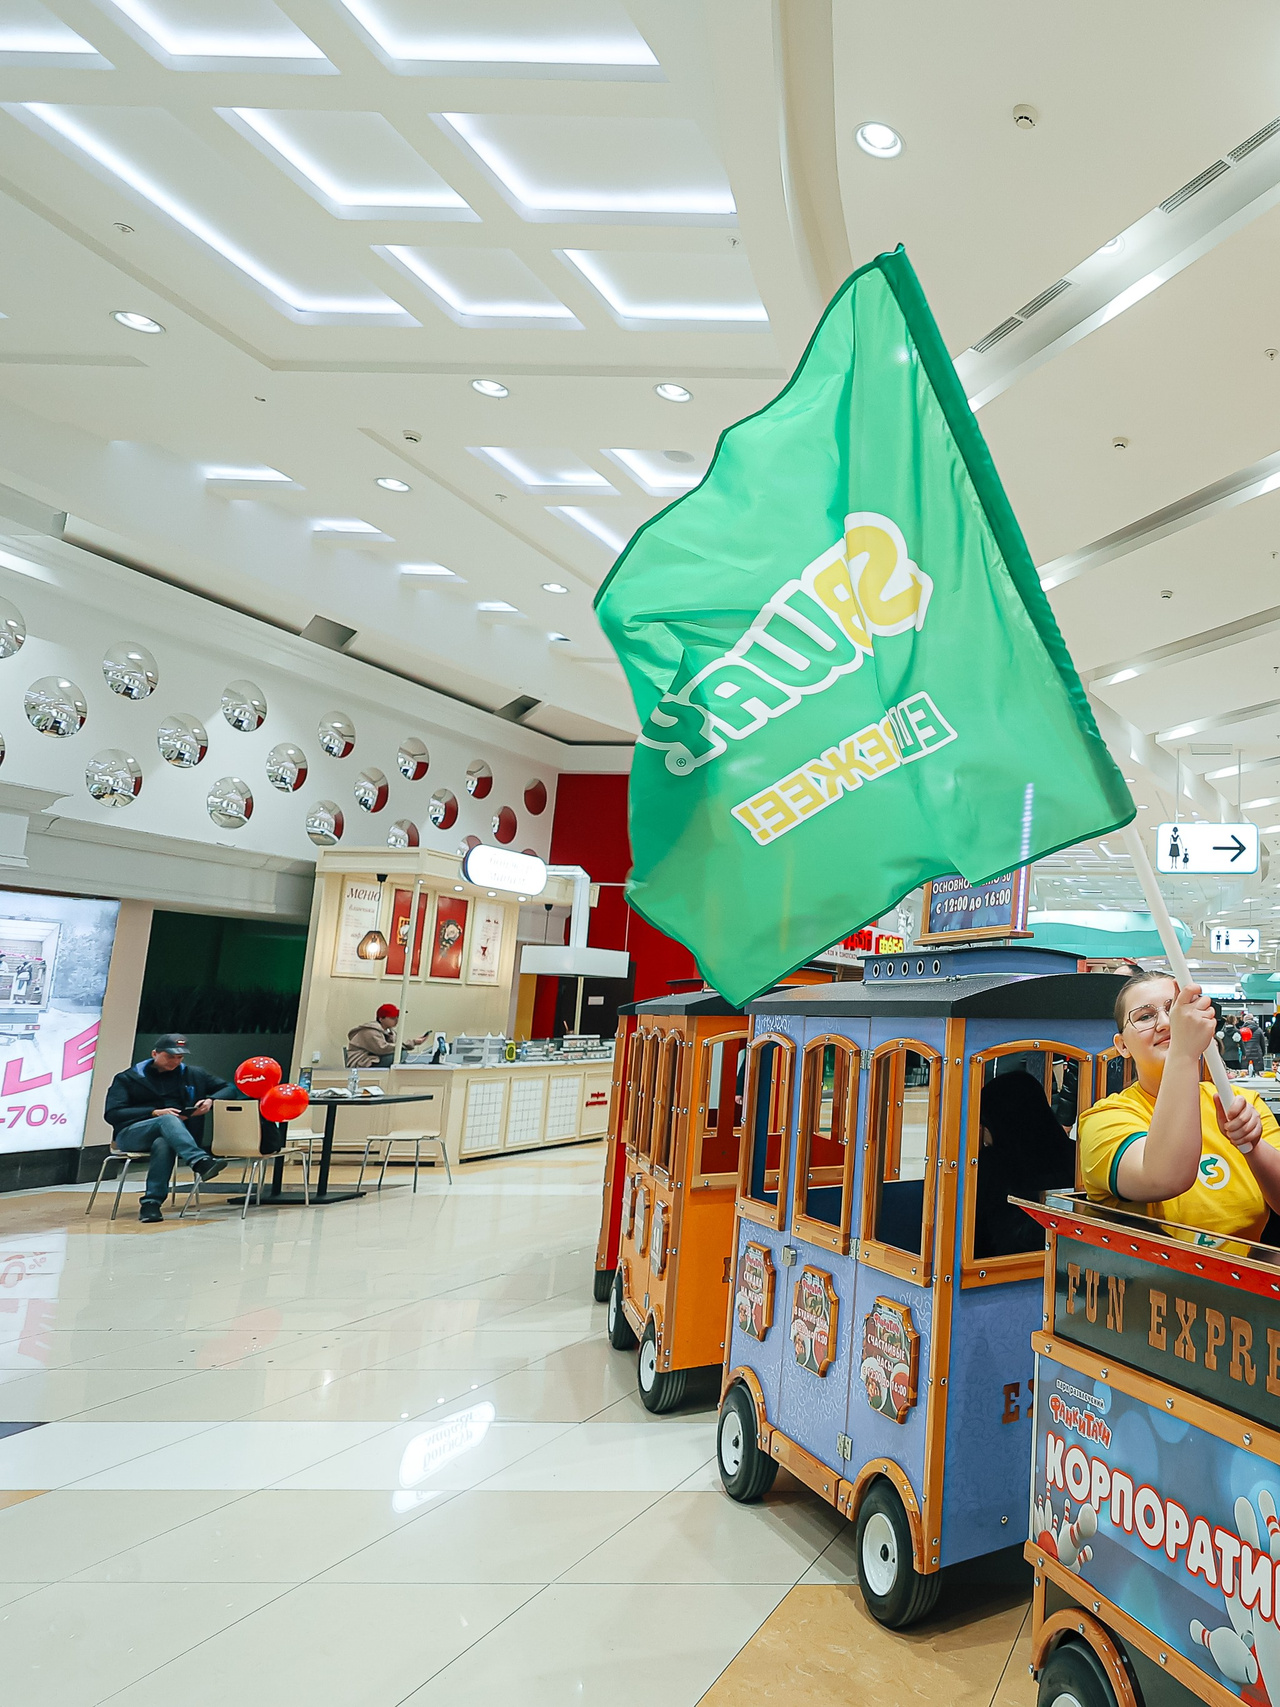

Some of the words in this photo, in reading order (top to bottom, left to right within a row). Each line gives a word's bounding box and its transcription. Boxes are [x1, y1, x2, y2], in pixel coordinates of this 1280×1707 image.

[932, 878, 973, 895] ОСНОВНО
[944, 896, 968, 913] 12:00
[985, 889, 1011, 907] 16:00
[1065, 1262, 1126, 1334] FUN
[867, 1334, 906, 1361] СЧАСТЛИВЫЕ
[876, 1355, 894, 1373] ЧАСЫ
[891, 1381, 907, 1397] 16:00
